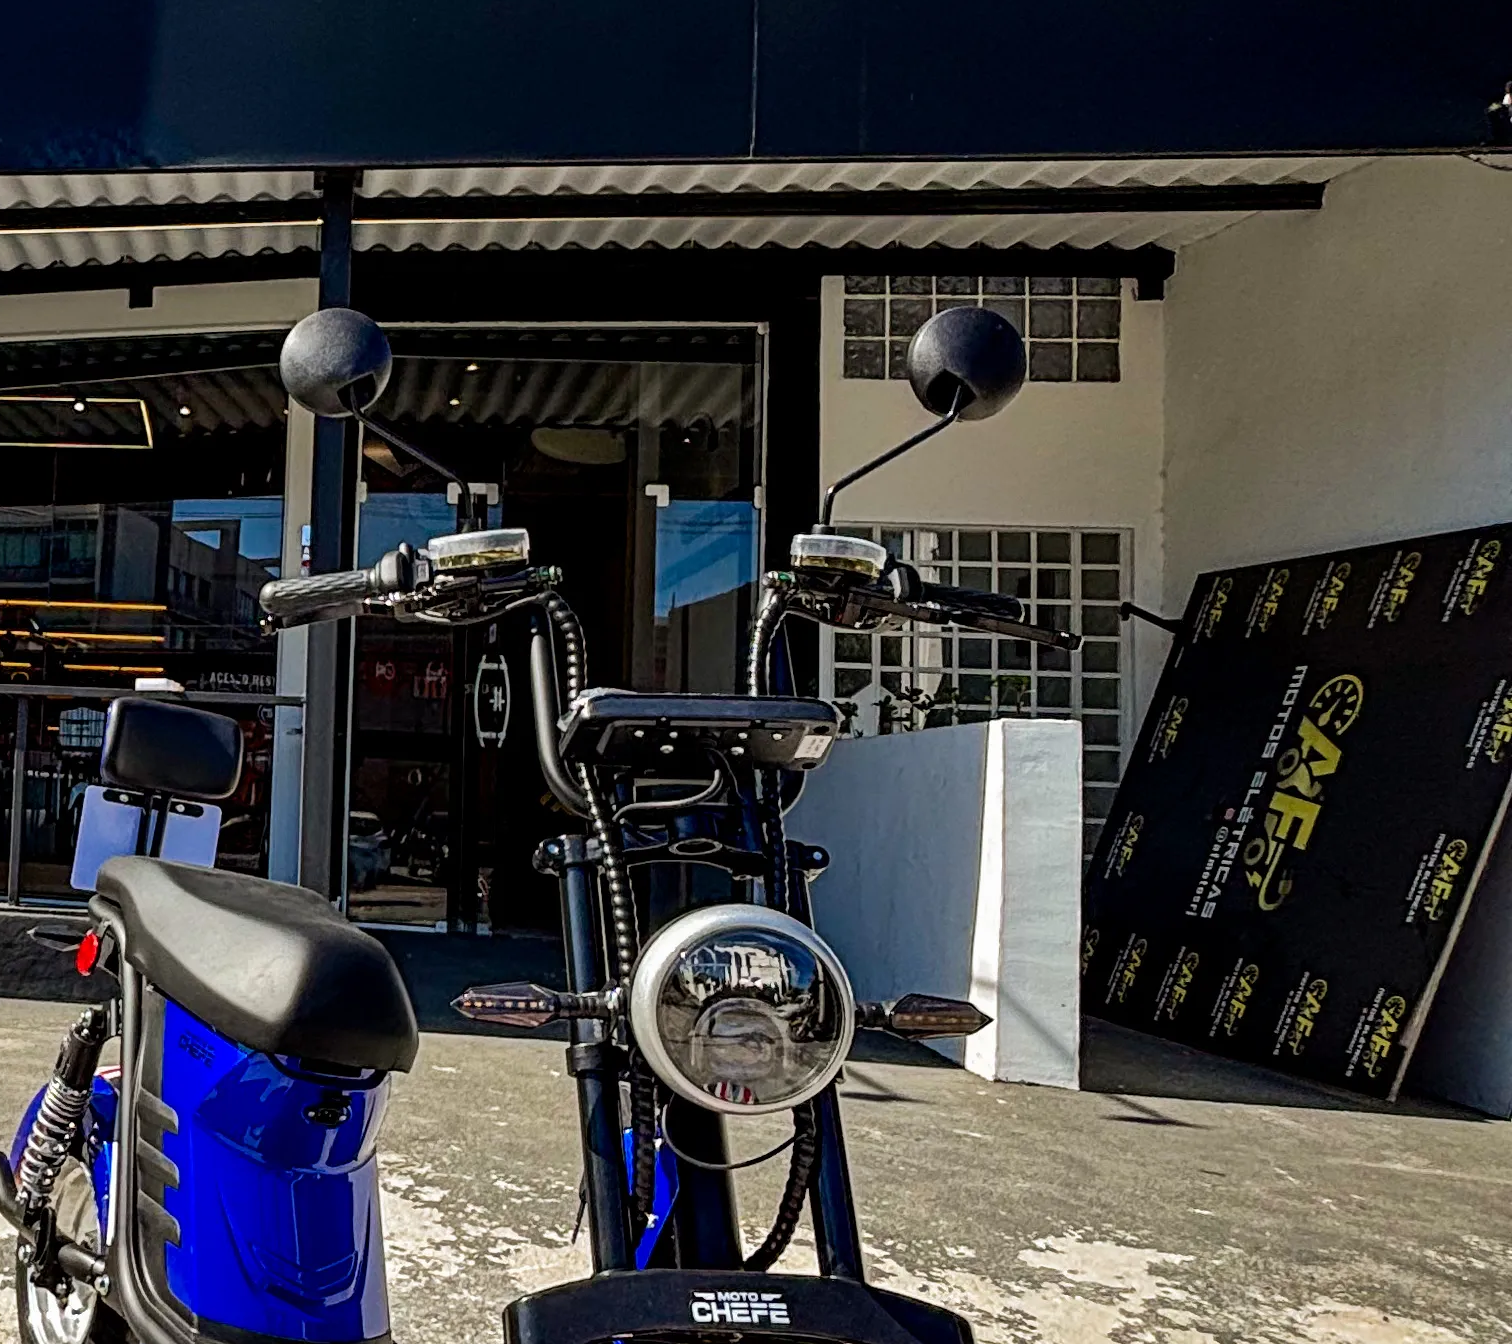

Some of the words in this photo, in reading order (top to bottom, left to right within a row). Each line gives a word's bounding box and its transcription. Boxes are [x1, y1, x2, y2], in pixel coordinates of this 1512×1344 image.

[1262, 665, 1308, 758] MOTOS
[1200, 771, 1267, 918] ELÉTRICAS
[692, 1302, 790, 1324] CHEFE
[717, 1291, 759, 1302] MOTO
